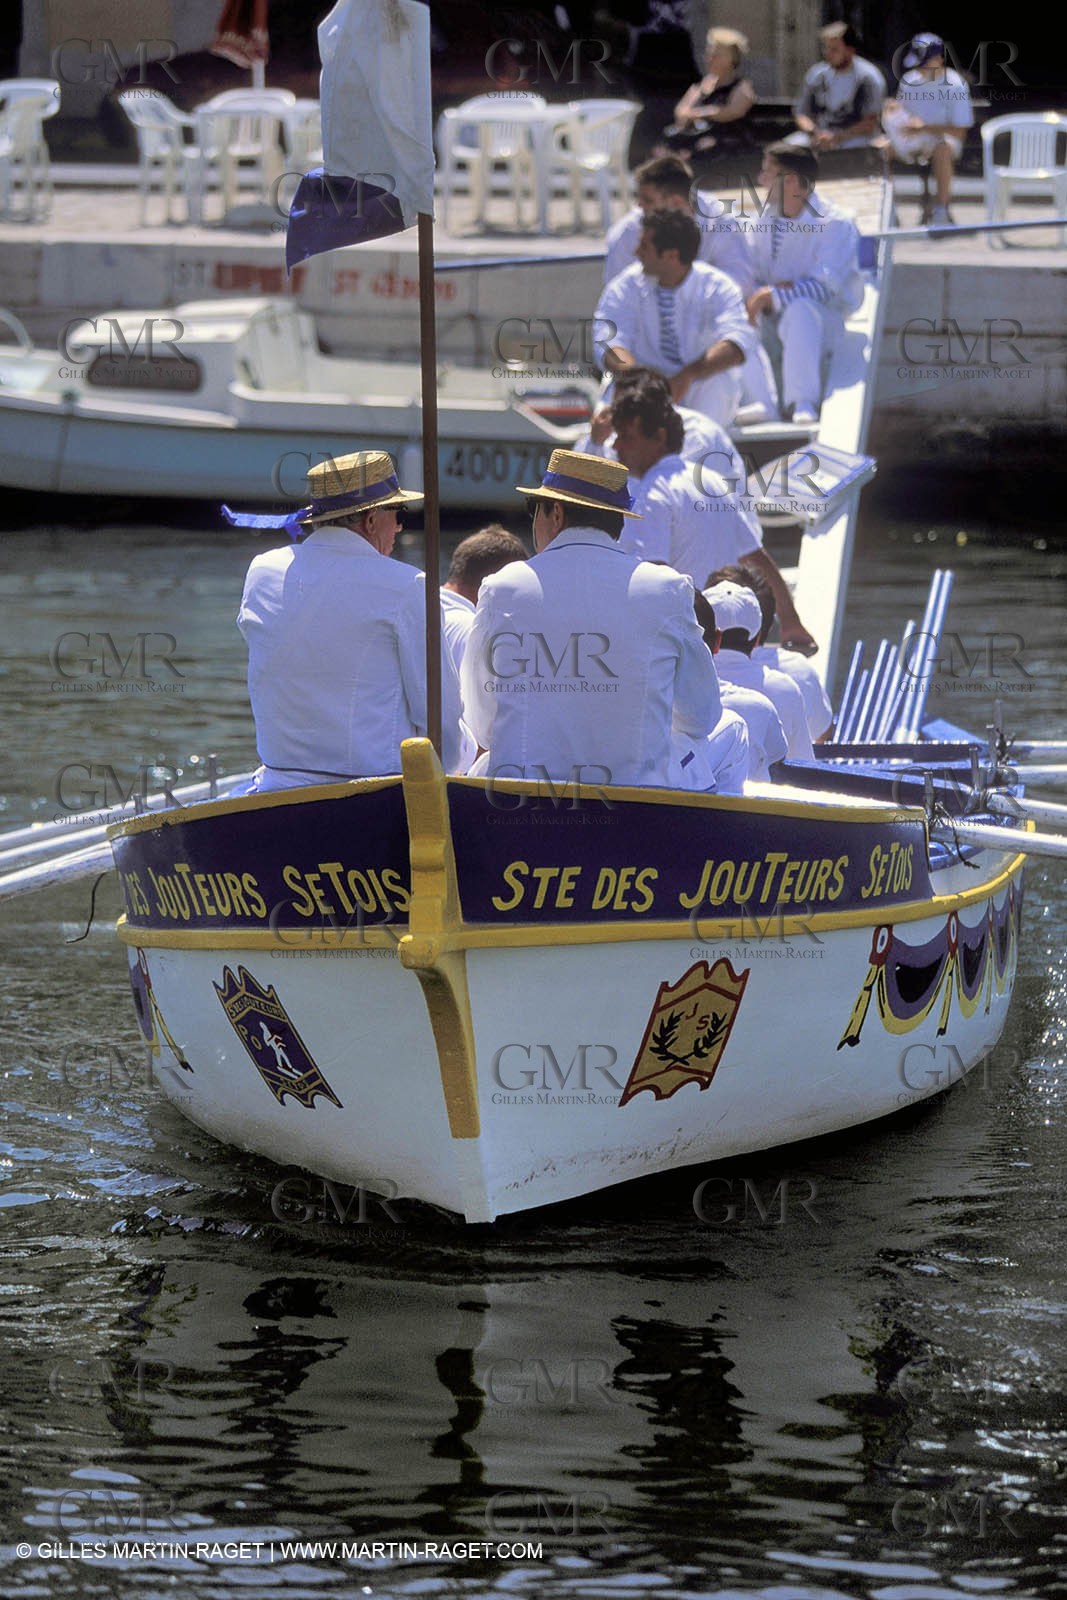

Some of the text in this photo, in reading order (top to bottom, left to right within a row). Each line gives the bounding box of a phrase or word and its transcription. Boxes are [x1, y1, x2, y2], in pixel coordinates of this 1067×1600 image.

[148, 863, 267, 921] JOUTEURS
[282, 862, 411, 917] SETOIS
[492, 842, 914, 912] STE DES JOUTEURS SETOIS
